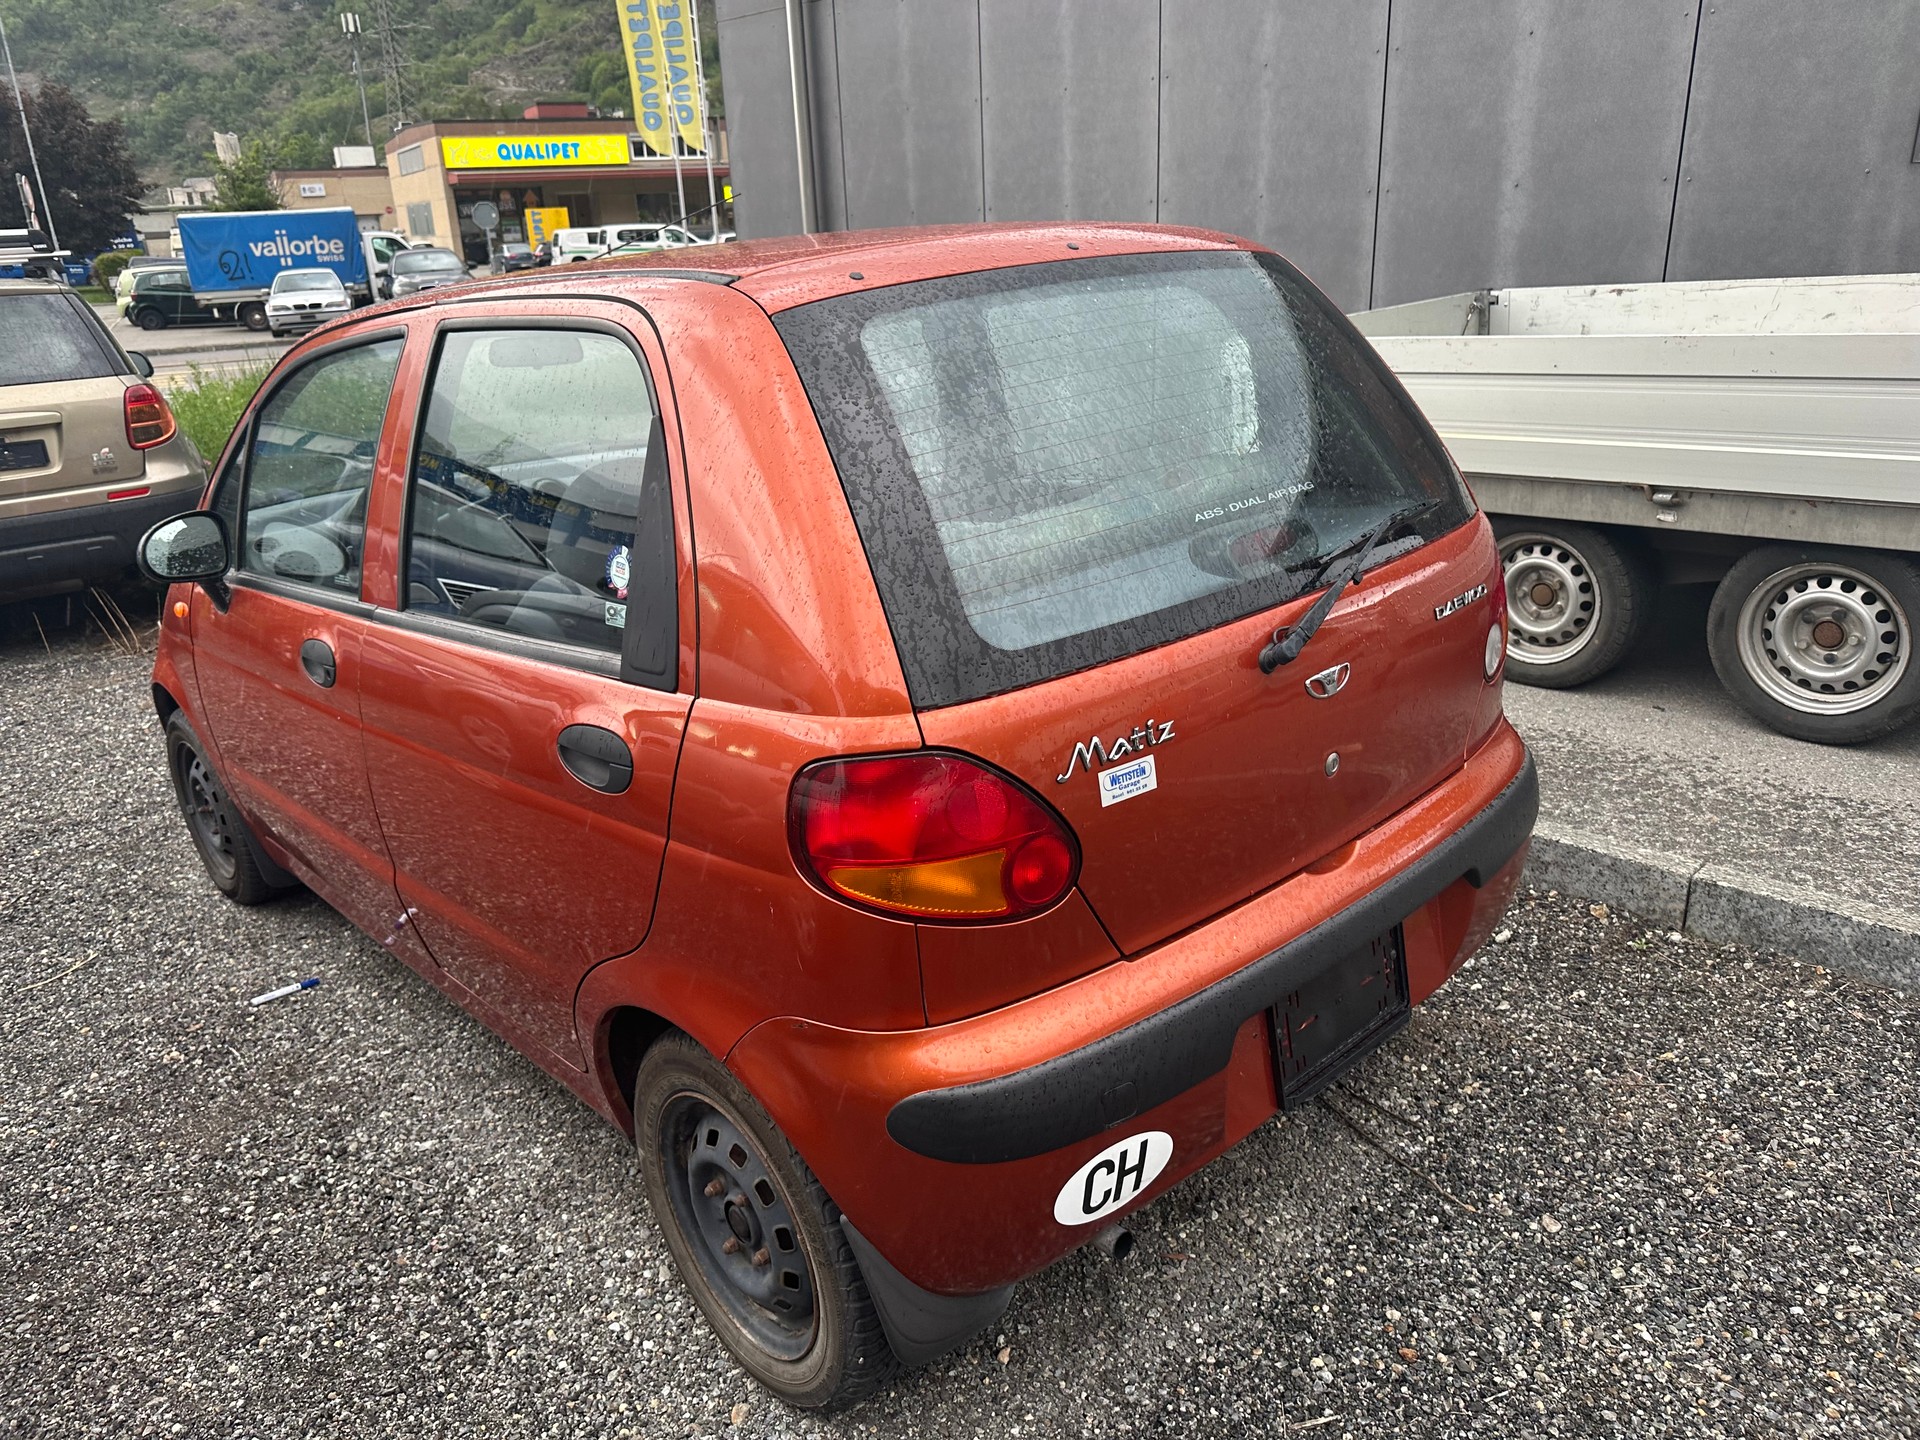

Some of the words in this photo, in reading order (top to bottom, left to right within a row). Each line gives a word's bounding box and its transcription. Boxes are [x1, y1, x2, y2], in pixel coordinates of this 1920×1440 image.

[497, 142, 580, 160] QUALIPET
[1194, 507, 1224, 522] ABS
[1229, 496, 1265, 512] DUAL
[1434, 583, 1487, 620] DAEWOO
[1056, 719, 1176, 783] Matiz
[1118, 780, 1141, 790] Garage
[1082, 1139, 1149, 1215] CH
